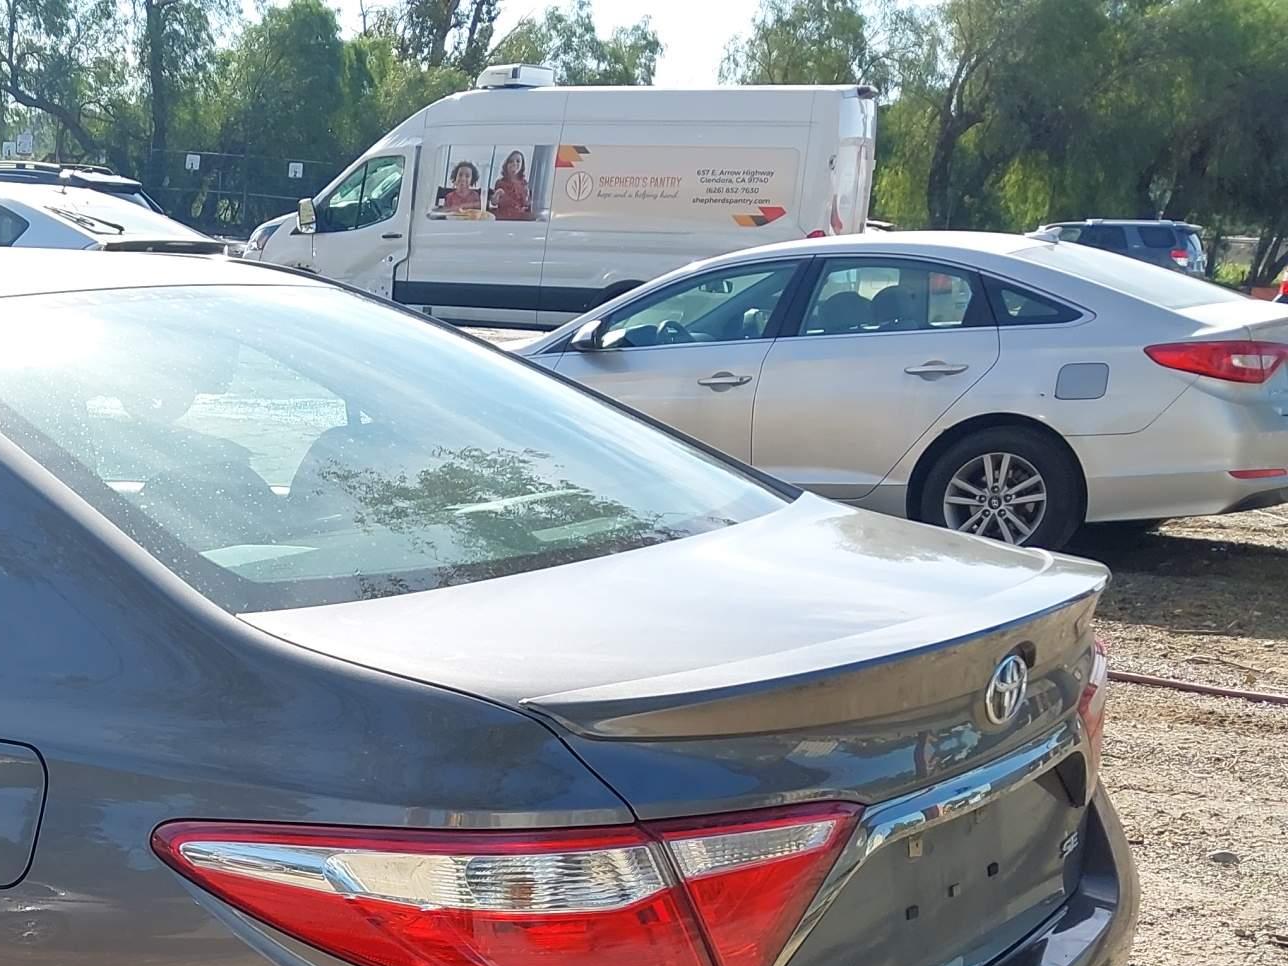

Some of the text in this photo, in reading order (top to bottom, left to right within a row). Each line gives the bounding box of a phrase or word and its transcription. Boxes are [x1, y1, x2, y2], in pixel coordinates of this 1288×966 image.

[742, 169, 774, 178] Highway
[599, 175, 681, 188] SHEPHERD'S PANTRY
[692, 197, 771, 205] shepherdspantry.com
